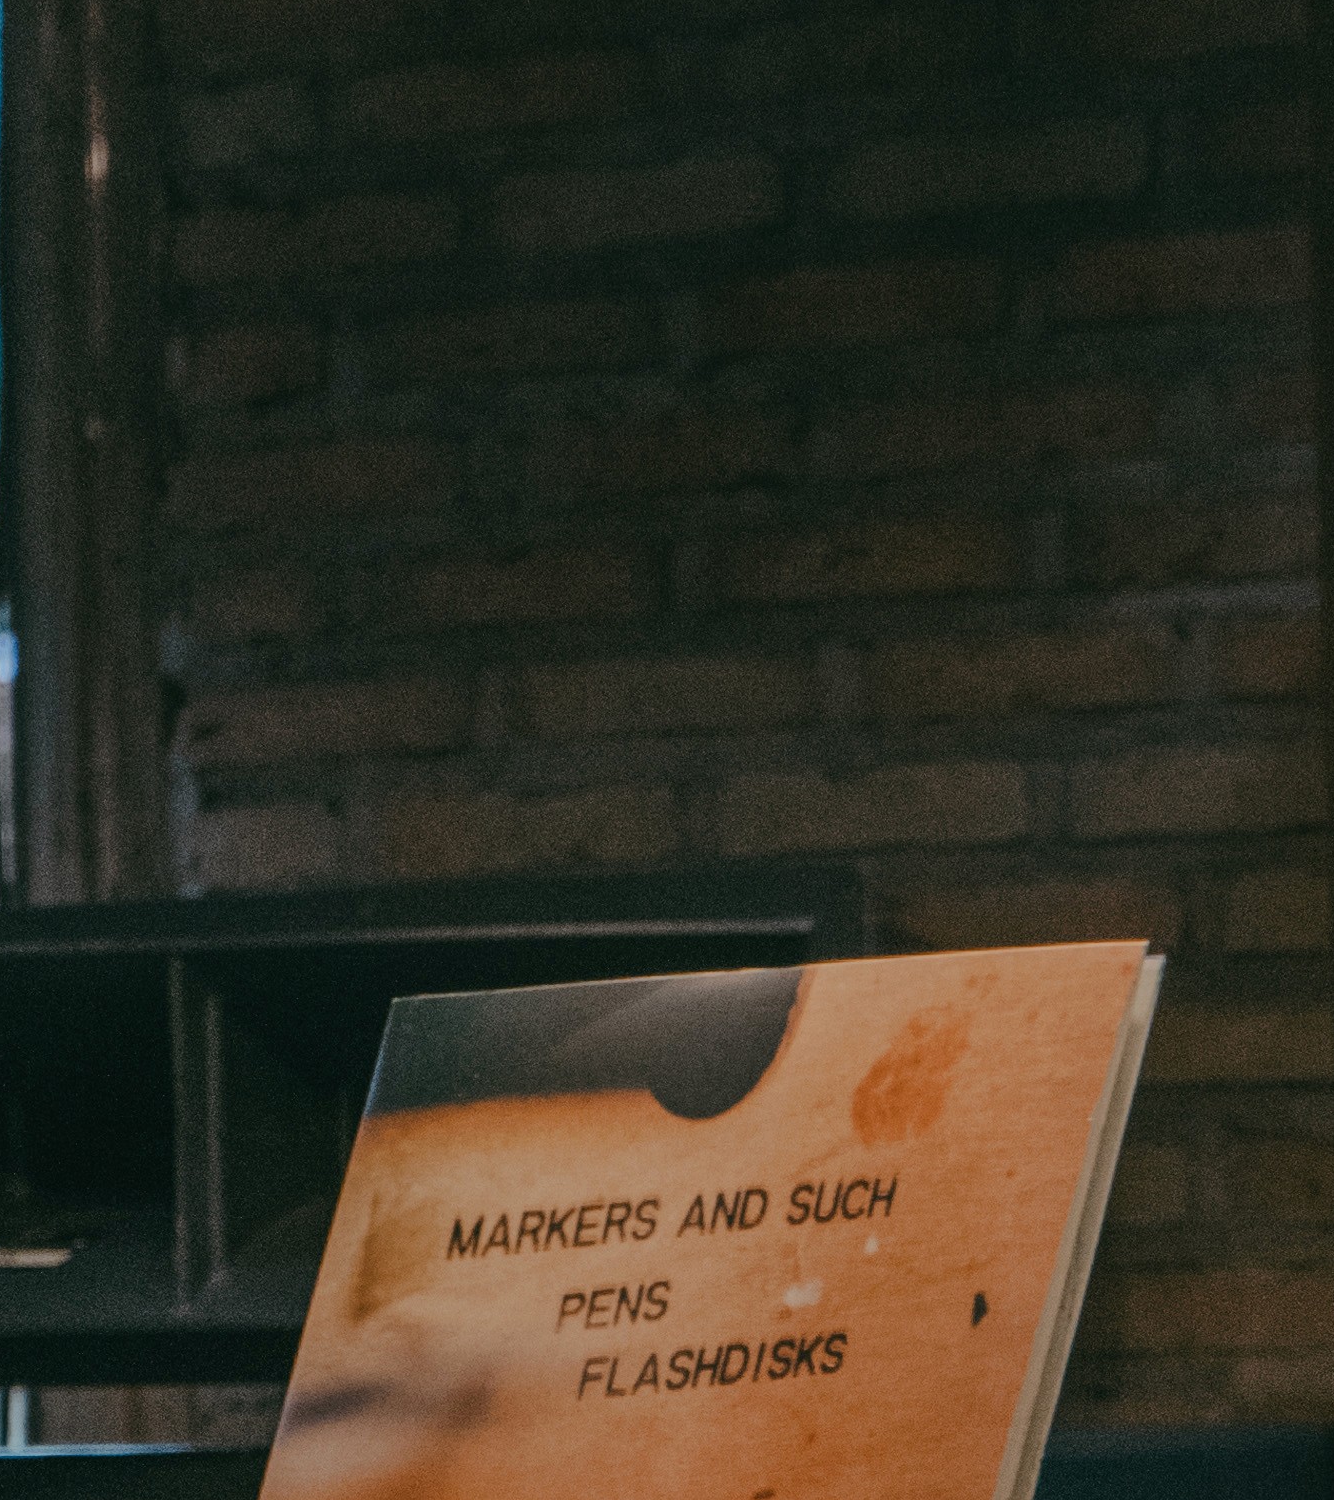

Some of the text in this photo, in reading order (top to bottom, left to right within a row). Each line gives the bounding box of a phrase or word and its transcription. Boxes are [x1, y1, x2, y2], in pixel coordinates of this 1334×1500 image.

[445, 1173, 900, 1260] MARKERS AND SUCH
[555, 1280, 671, 1333] PENS
[577, 1331, 849, 1401] FLASHDISKS
